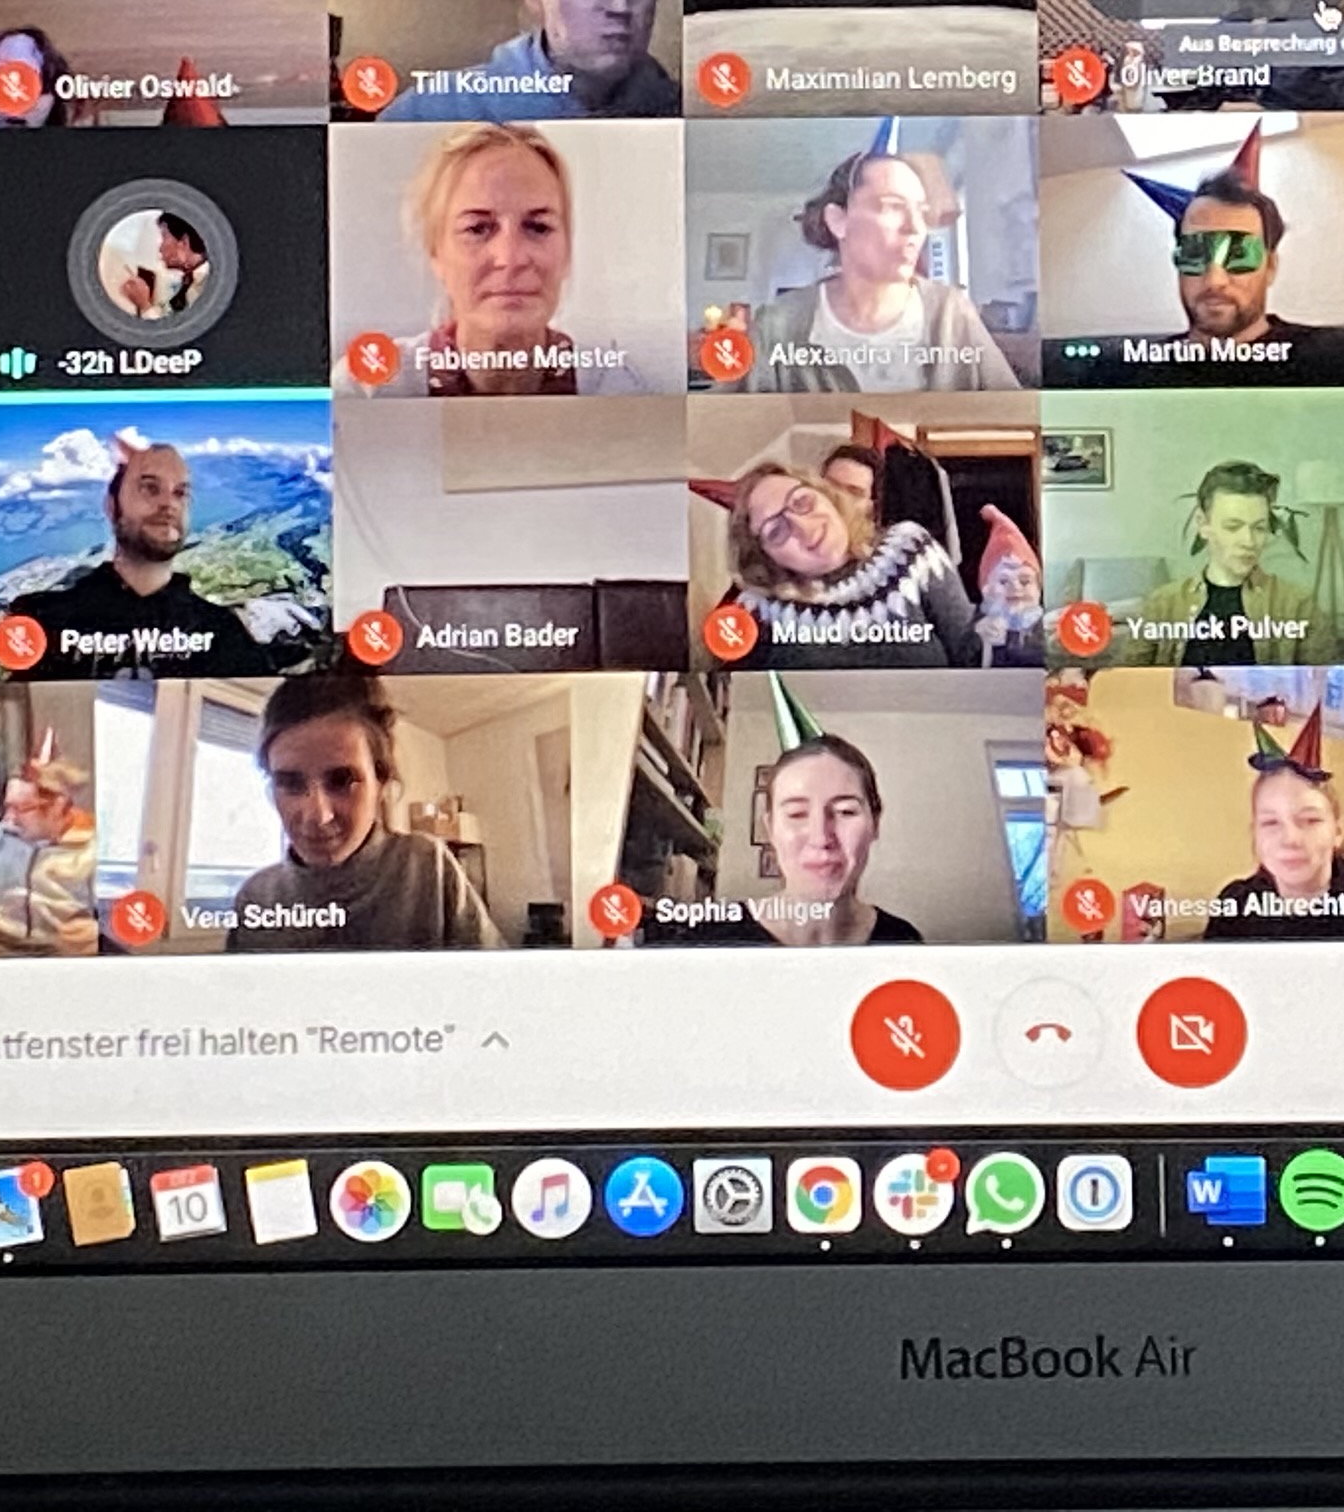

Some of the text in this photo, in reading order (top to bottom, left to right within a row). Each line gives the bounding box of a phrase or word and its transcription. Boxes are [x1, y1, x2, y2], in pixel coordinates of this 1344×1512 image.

[1178, 33, 1218, 53] Aus
[1223, 32, 1337, 57] Besprechung
[411, 69, 573, 96] Till Könneker
[766, 66, 1017, 94] Maximilian Lemberg
[1197, 61, 1271, 85] Brand
[56, 75, 132, 101] Olivier
[414, 345, 628, 371] Fabienne Meister
[769, 342, 986, 367] Alexandra Tanner
[1123, 336, 1293, 364] Martin Moser
[416, 623, 579, 649] Adrian Bader
[771, 619, 935, 644] Maud Cottier
[1126, 614, 1309, 641] Yannick Pulver
[60, 628, 215, 655] Peter Weber
[181, 903, 347, 930] Vera Schürch
[656, 897, 835, 926] Sophia Villiger
[1129, 894, 1238, 919] Vanessa
[137, 1029, 192, 1058] frei
[199, 1028, 299, 1057] halten
[1193, 1180, 1222, 1204] W
[167, 1192, 207, 1225] 10
[901, 1335, 1198, 1380] MacBook Air
